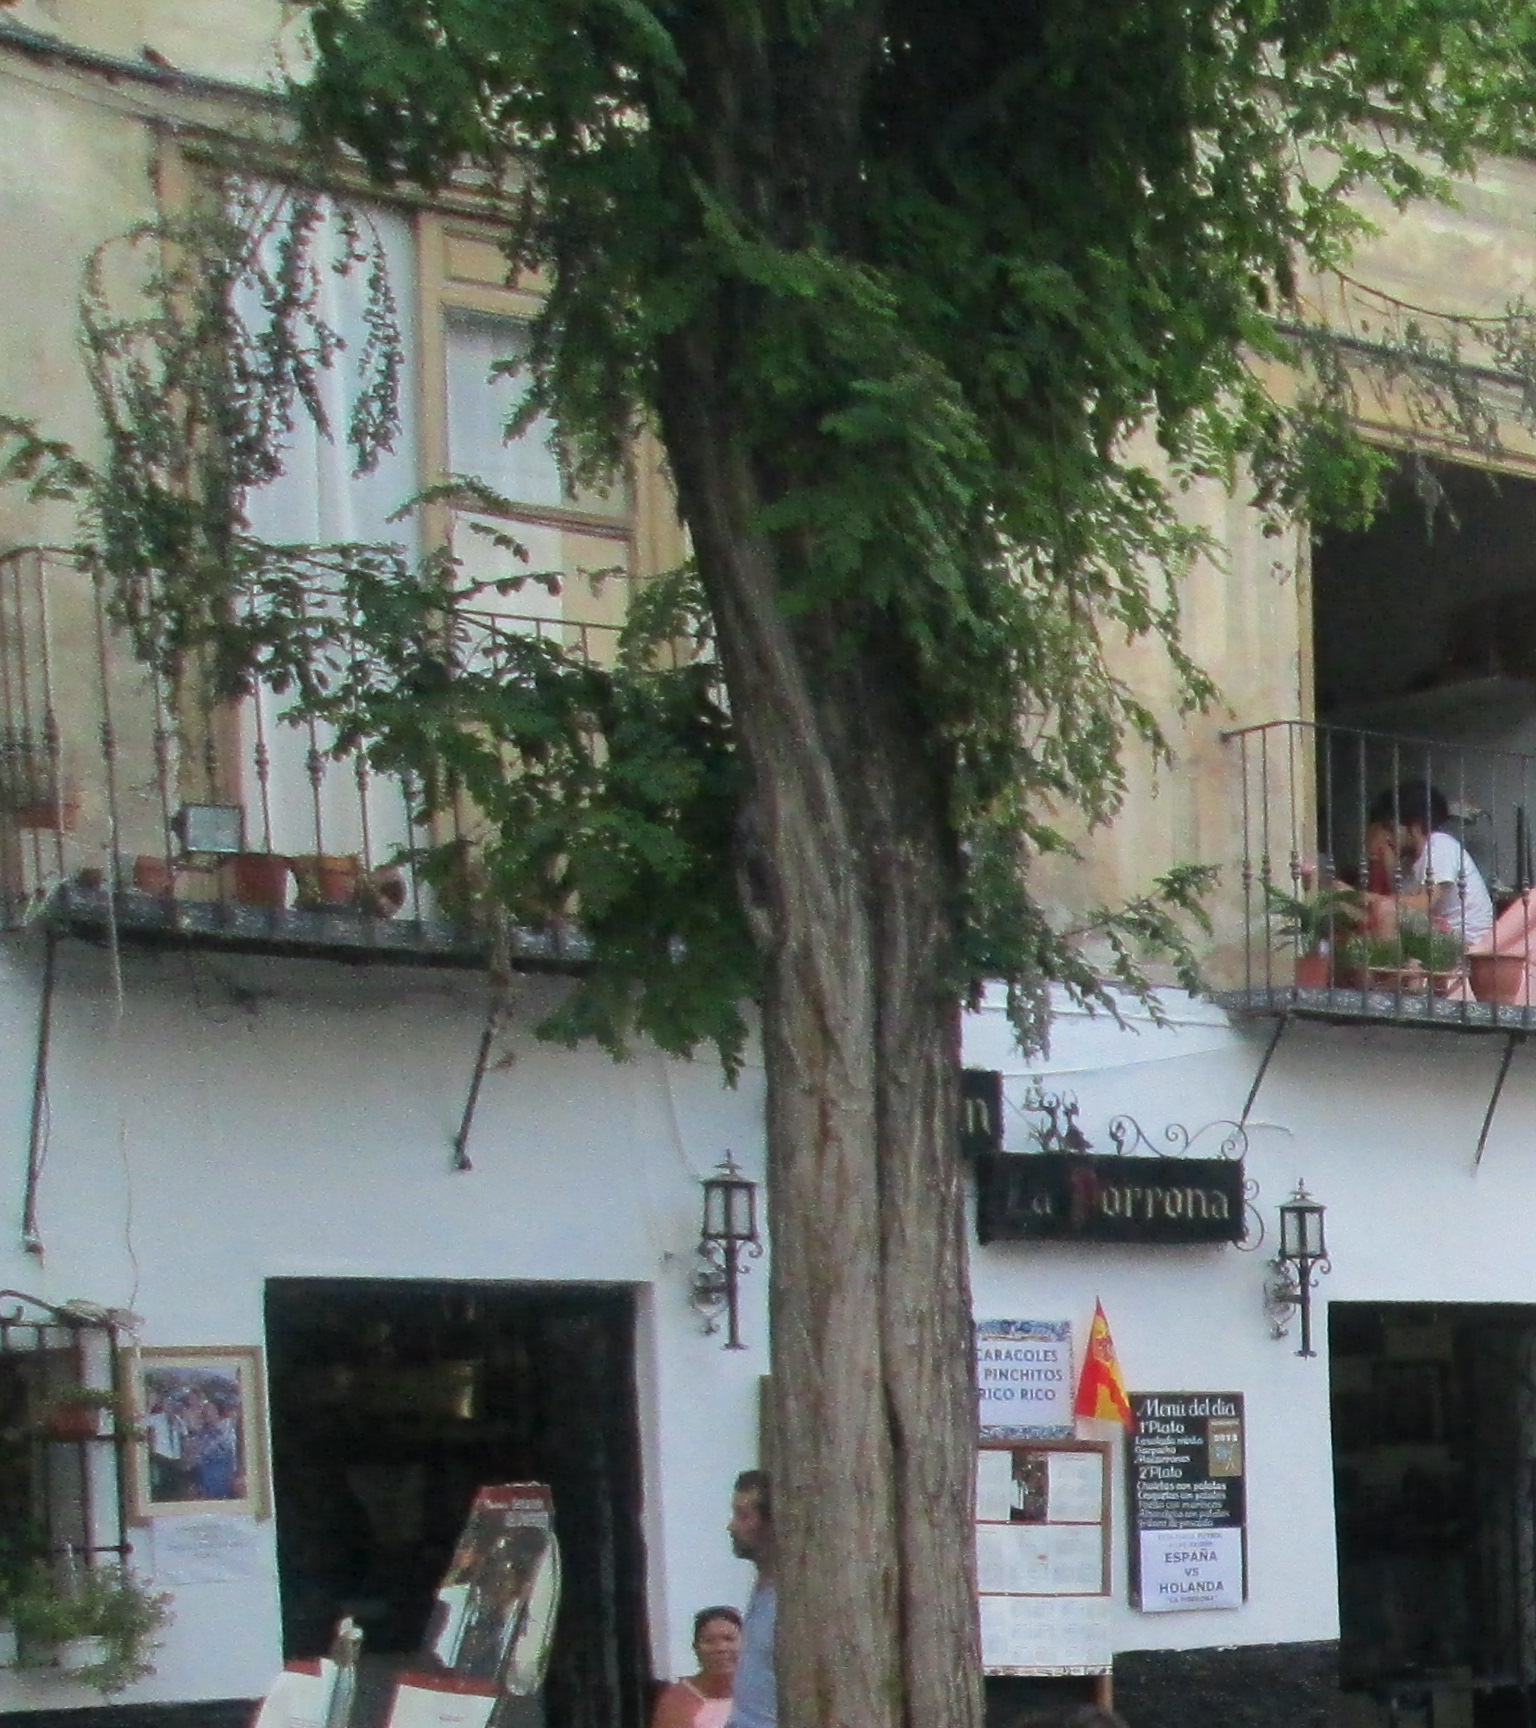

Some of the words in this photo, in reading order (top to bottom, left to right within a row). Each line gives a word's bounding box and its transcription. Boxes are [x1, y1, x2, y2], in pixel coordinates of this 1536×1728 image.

[1071, 1167, 1229, 1228] Porrona
[984, 1368, 1062, 1381] PINCHITOS
[978, 1388, 1014, 1400] RICO
[1020, 1388, 1055, 1401] RICO
[1137, 1398, 1186, 1417] Menú
[1188, 1399, 1210, 1416] del
[1164, 1548, 1217, 1563] ESPAÑA
[1159, 1581, 1224, 1594] HOLANDA
